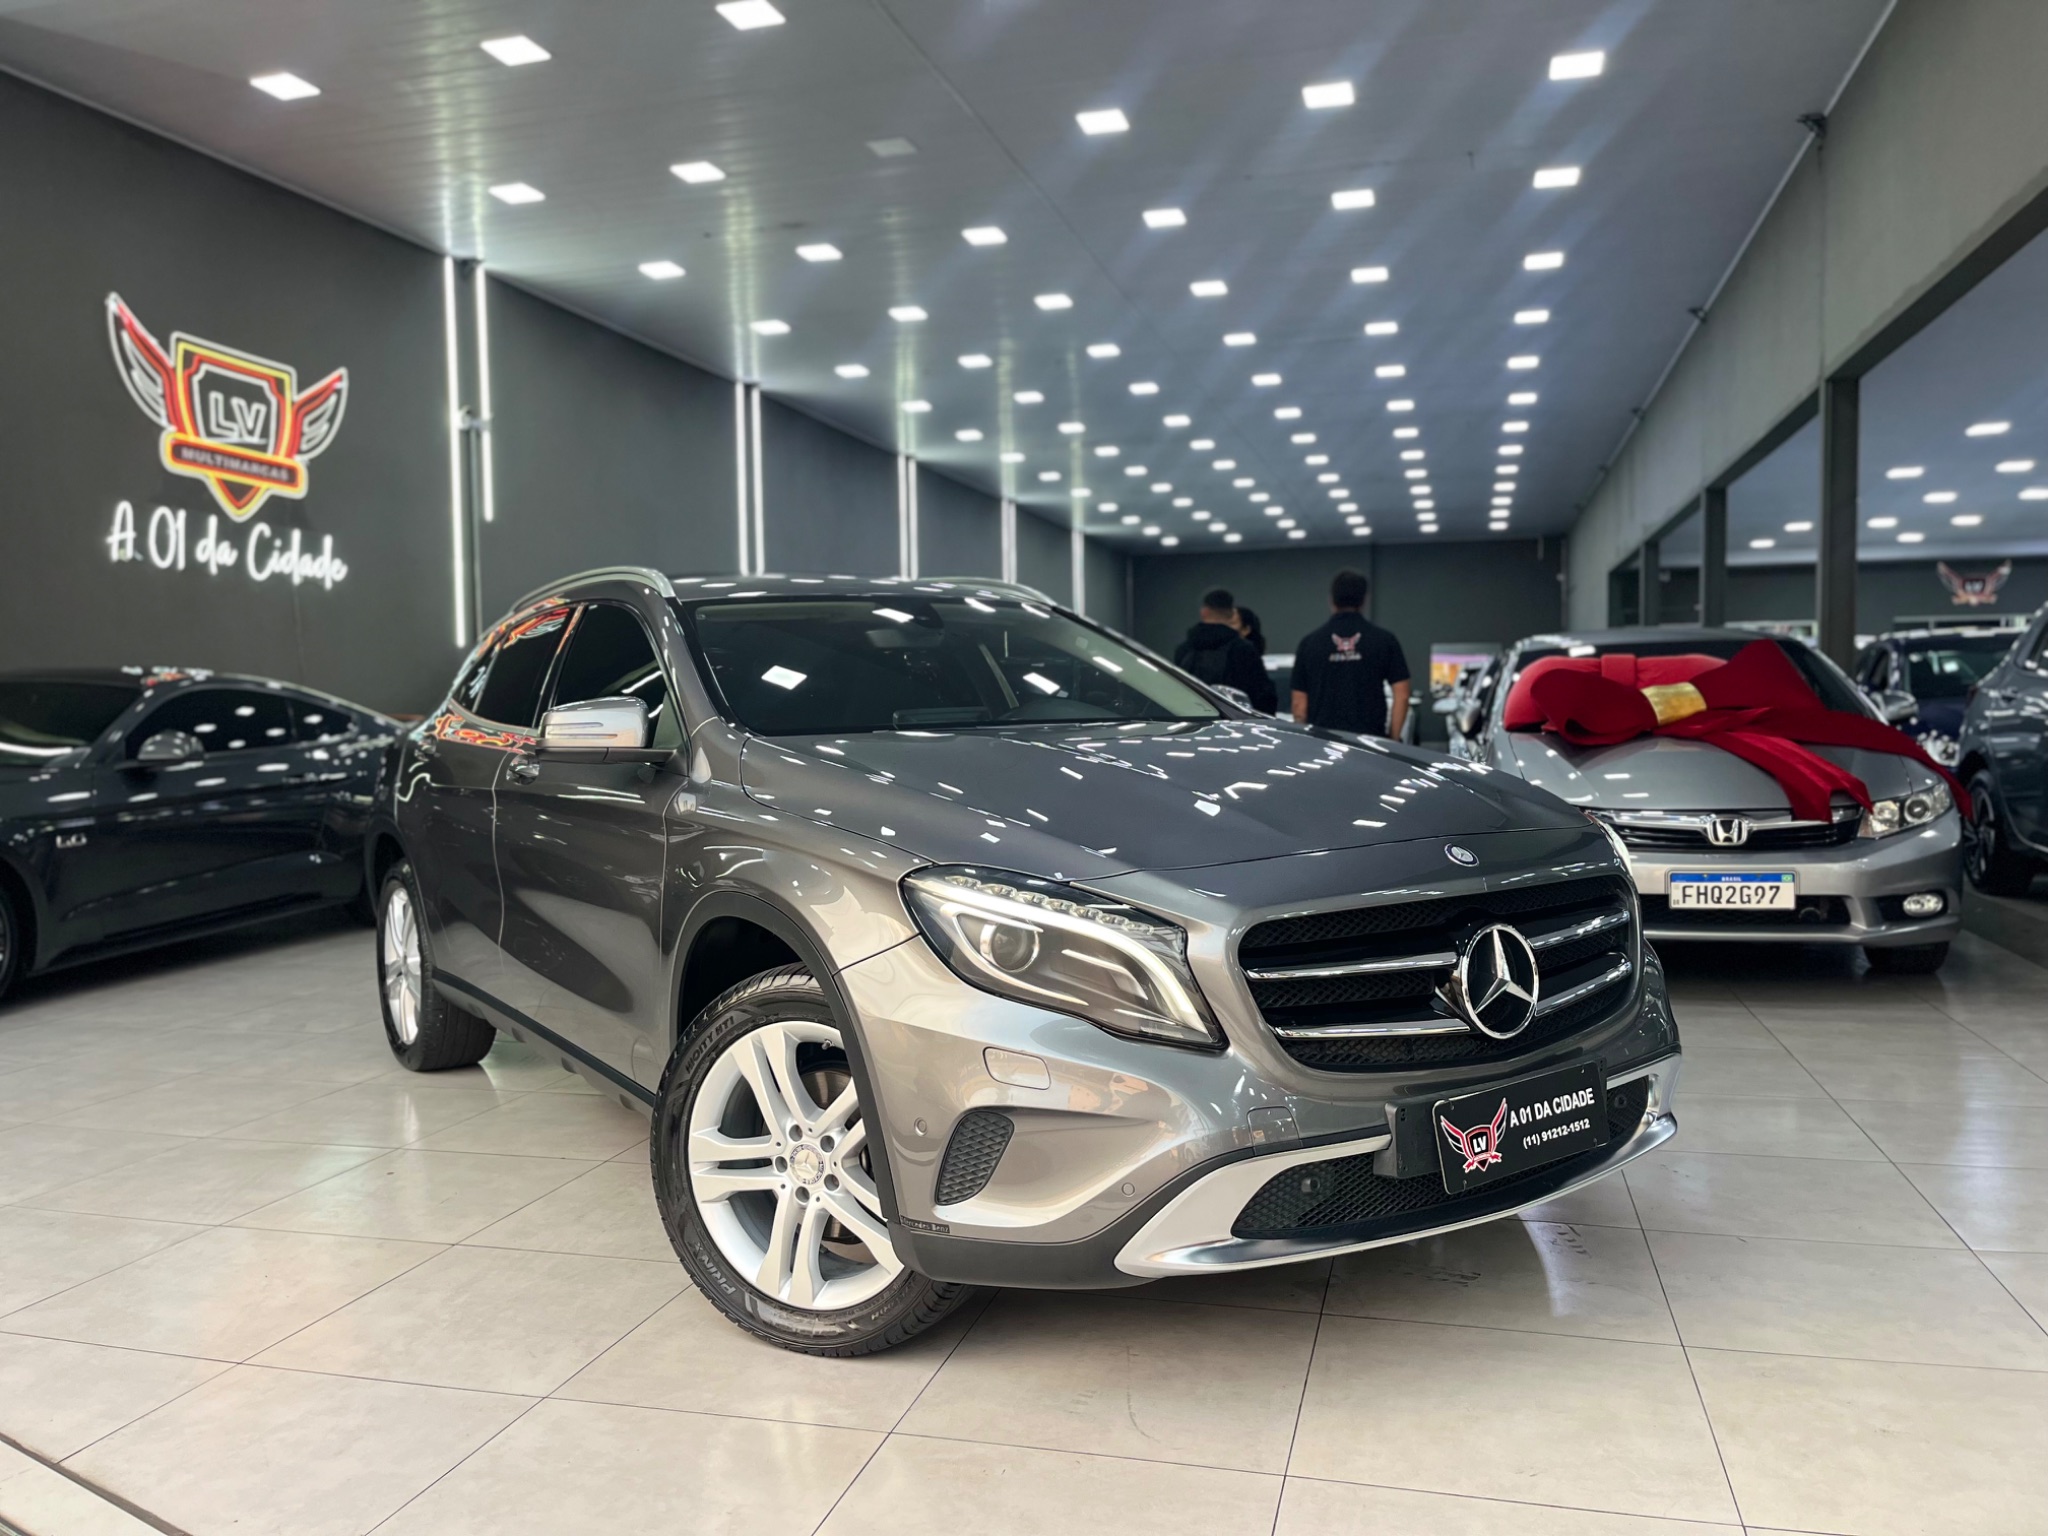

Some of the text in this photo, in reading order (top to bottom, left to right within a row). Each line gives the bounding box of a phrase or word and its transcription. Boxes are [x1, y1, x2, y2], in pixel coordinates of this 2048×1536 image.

[209, 391, 267, 442] LV
[181, 447, 289, 480] MULTIMARCAS
[106, 501, 136, 562] A
[195, 514, 238, 576] da
[246, 522, 348, 590] Cidade
[1682, 885, 1781, 905] FHQ2G97
[1721, 875, 1742, 883] BRASIL
[1510, 1087, 1595, 1128] A 01 DA CIDADE
[1472, 1135, 1487, 1153] LV
[1522, 1118, 1590, 1150] (11) 91212-1512
